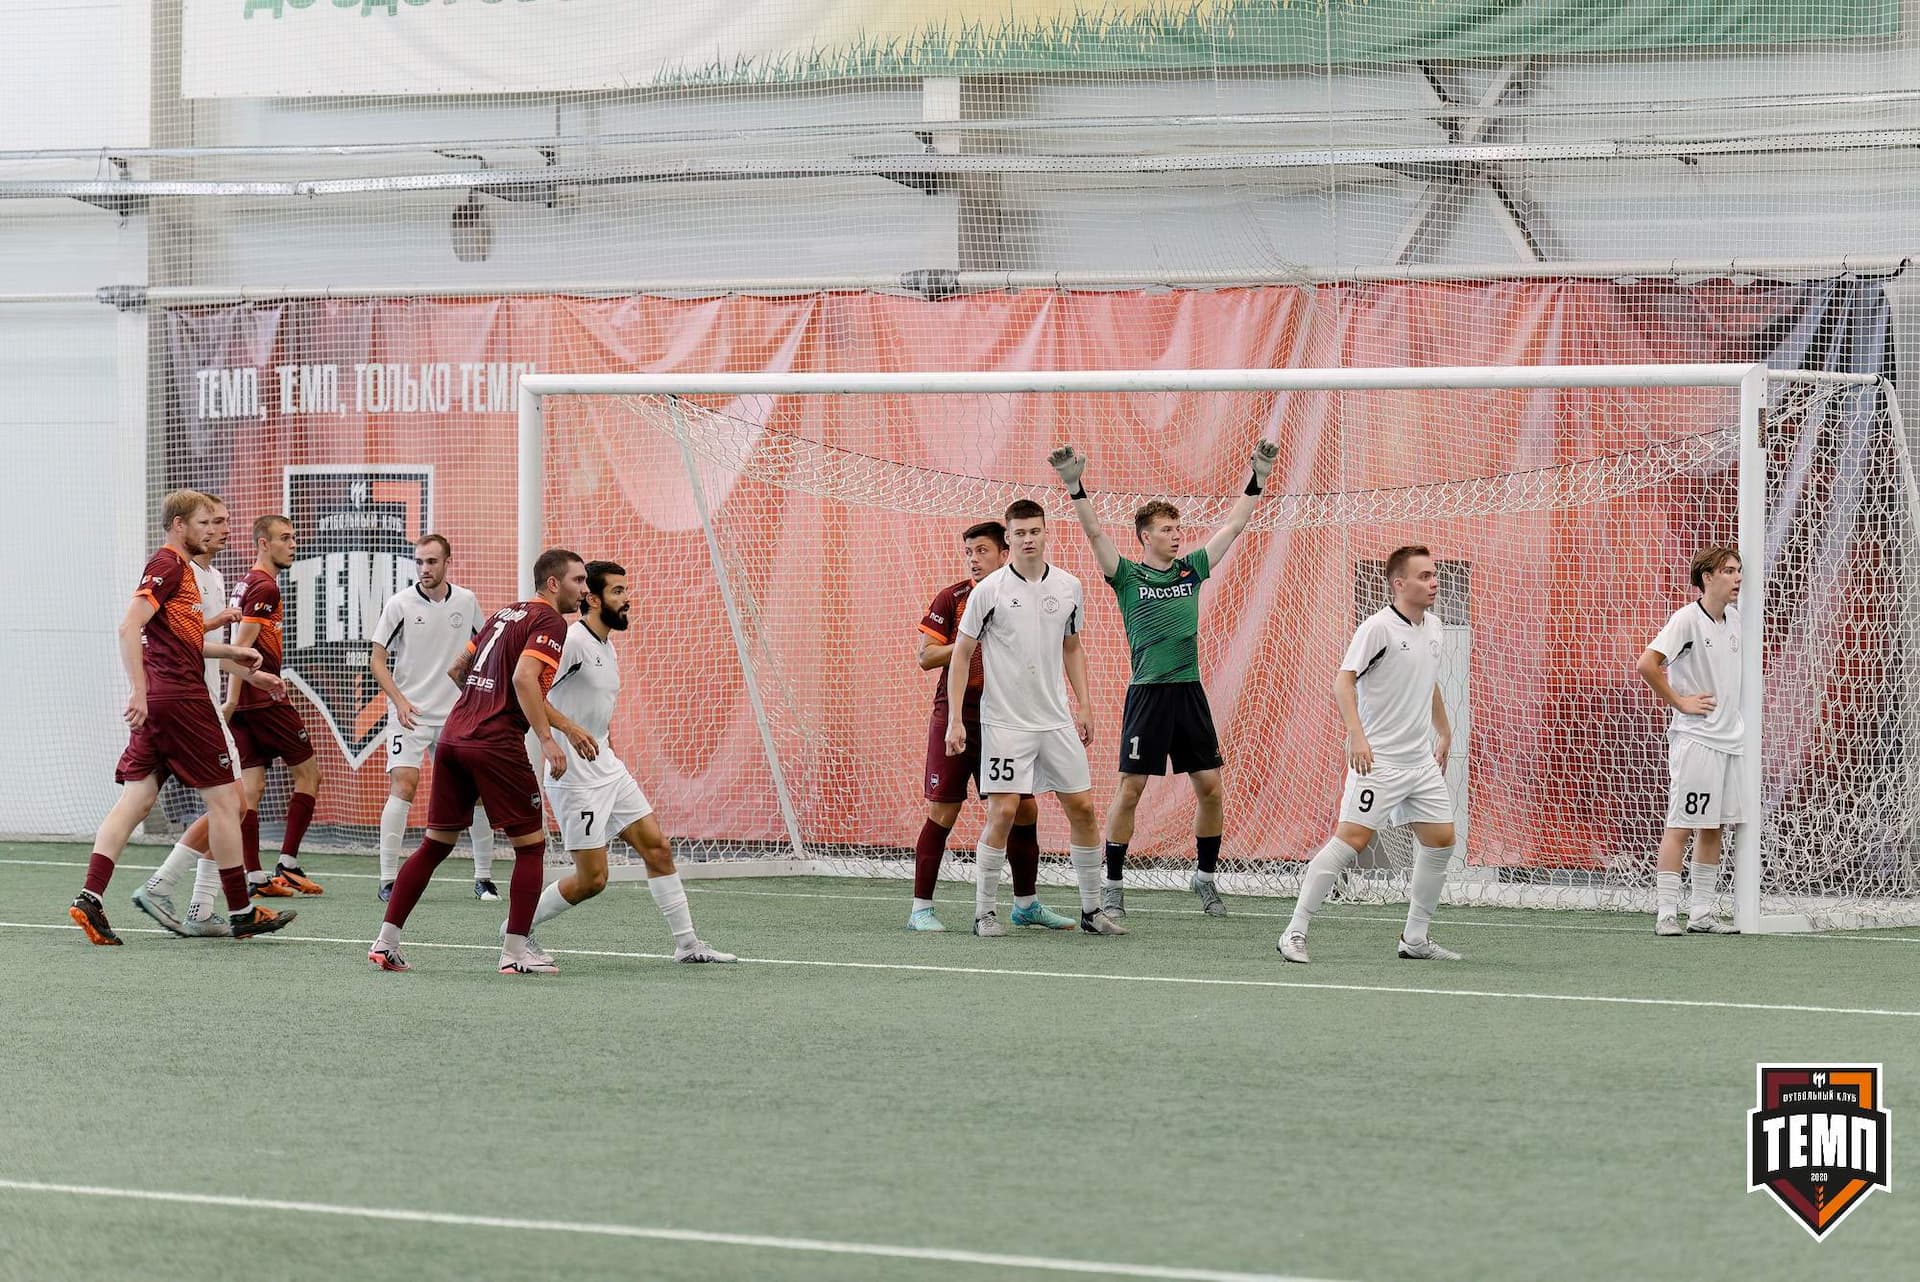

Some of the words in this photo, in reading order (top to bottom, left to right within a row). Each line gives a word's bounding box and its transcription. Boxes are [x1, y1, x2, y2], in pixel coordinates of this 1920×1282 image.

[197, 367, 267, 420] ТЕМП,
[275, 364, 346, 418] ТЕМП,
[354, 362, 450, 412] ТОЛЬКО
[1139, 583, 1192, 599] РАССВЕТ
[392, 734, 403, 755] 5
[1128, 736, 1140, 760] 1
[989, 757, 1014, 781] 35
[1358, 789, 1374, 813] 9
[1685, 792, 1710, 815] 87
[581, 811, 594, 836] 7
